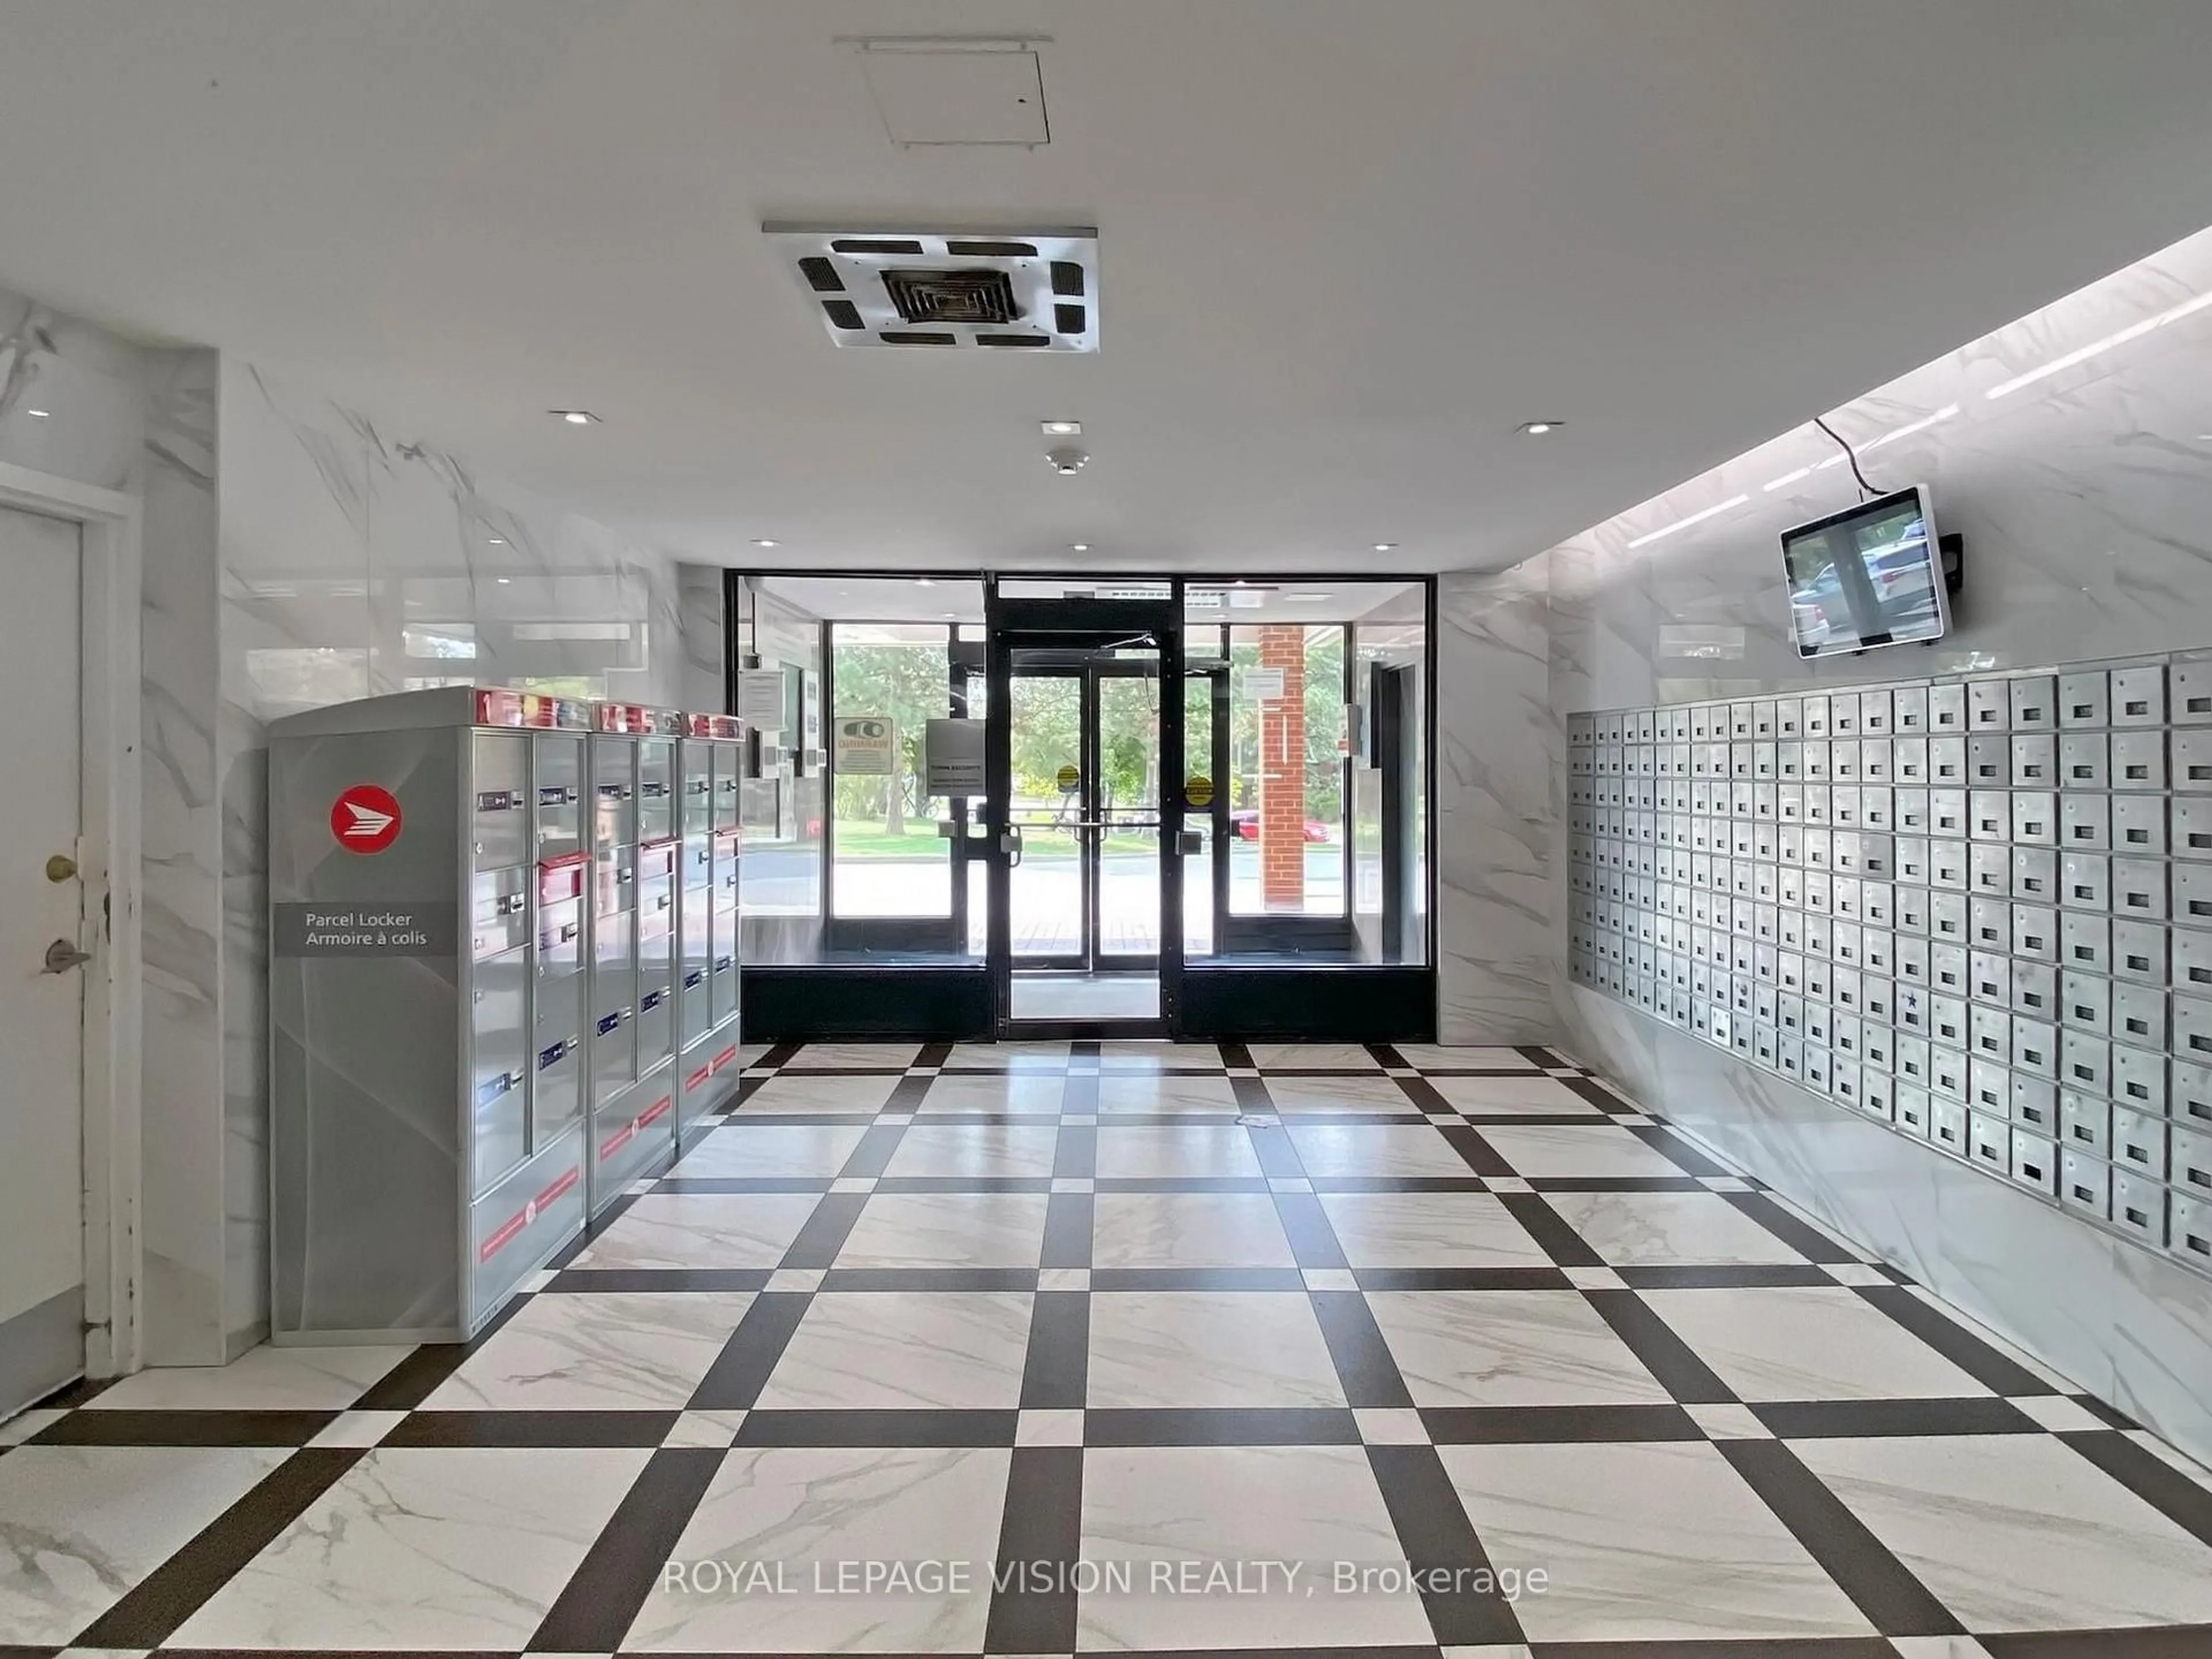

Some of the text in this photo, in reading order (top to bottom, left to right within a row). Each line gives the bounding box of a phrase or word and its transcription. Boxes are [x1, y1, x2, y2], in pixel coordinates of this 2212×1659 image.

[306, 912, 412, 926] Parcel Locker
[306, 930, 427, 945] Armoire à colis
